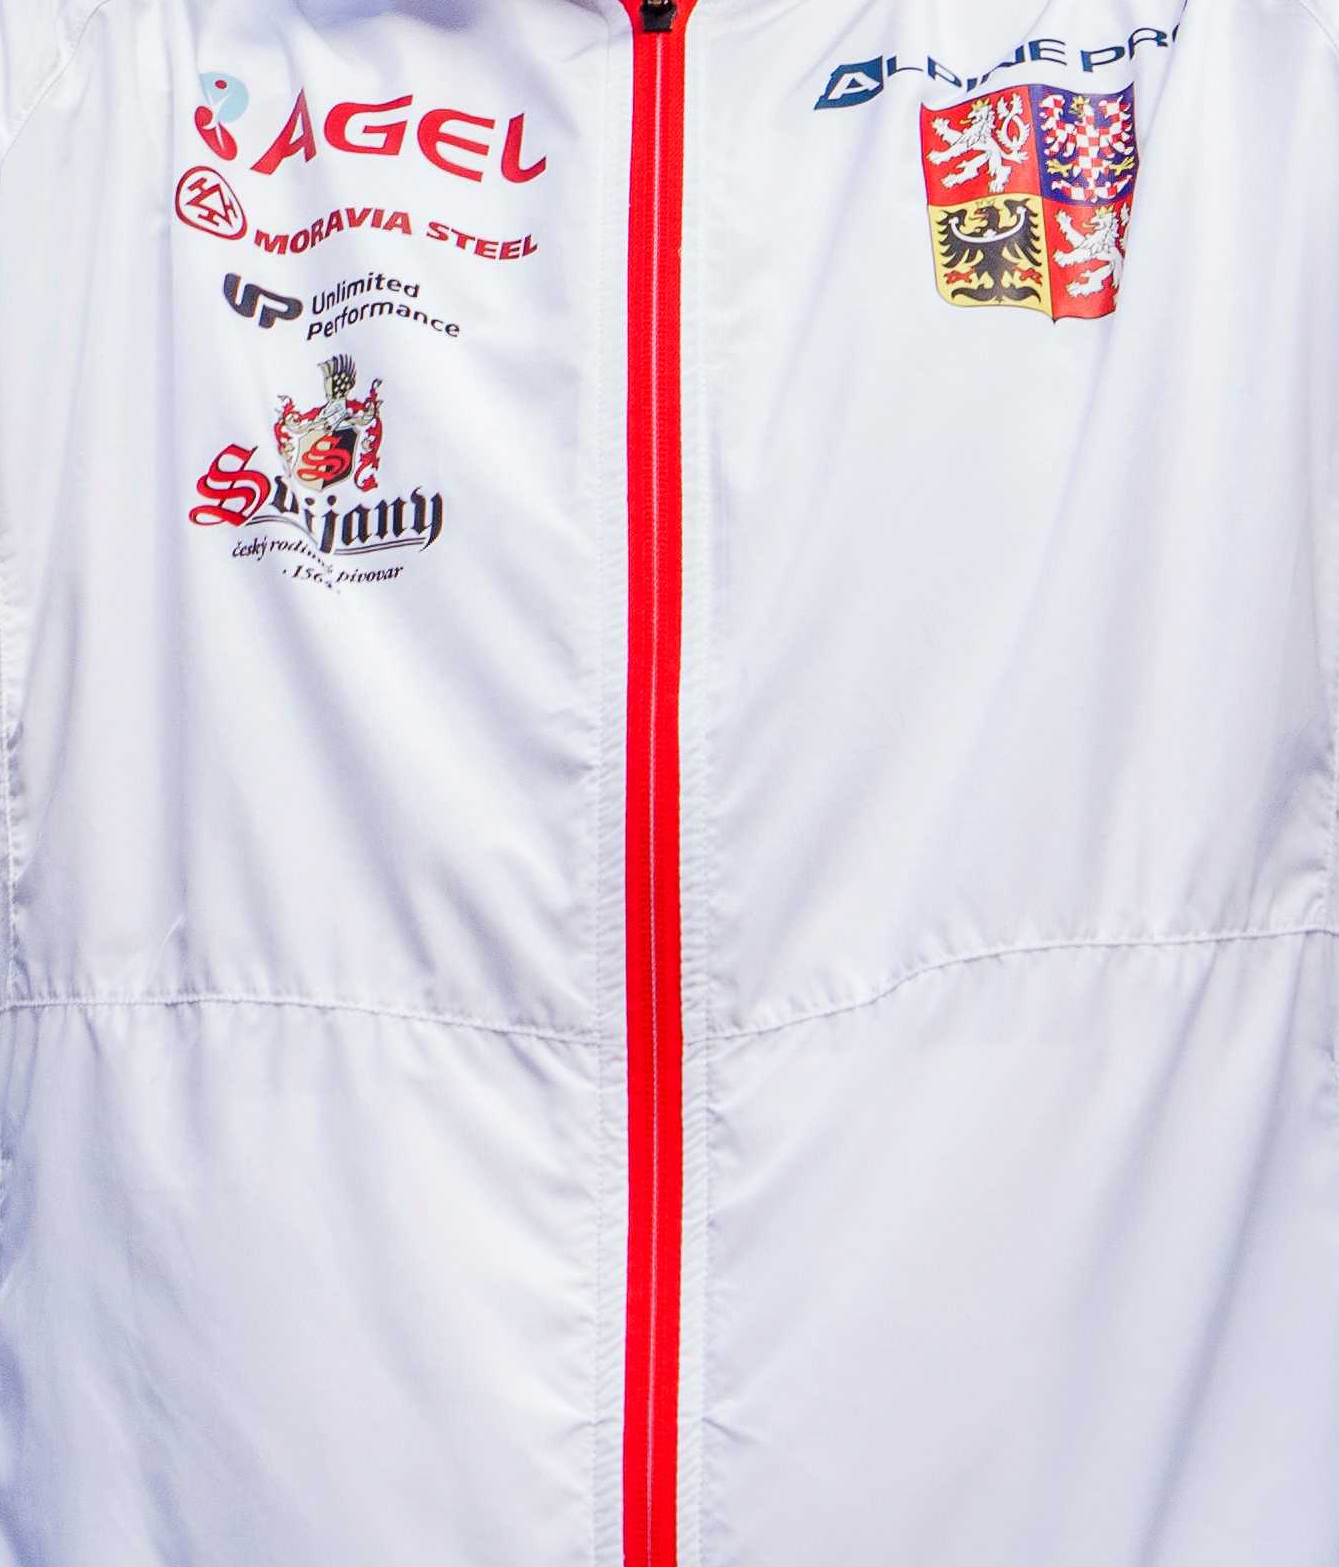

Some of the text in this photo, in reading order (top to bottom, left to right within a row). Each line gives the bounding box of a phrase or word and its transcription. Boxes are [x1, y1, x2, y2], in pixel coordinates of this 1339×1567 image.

[249, 86, 547, 184] AGEL
[253, 207, 538, 261] MORAVIA STEEL
[311, 271, 421, 316] Unlimited
[306, 299, 461, 341] Performance
